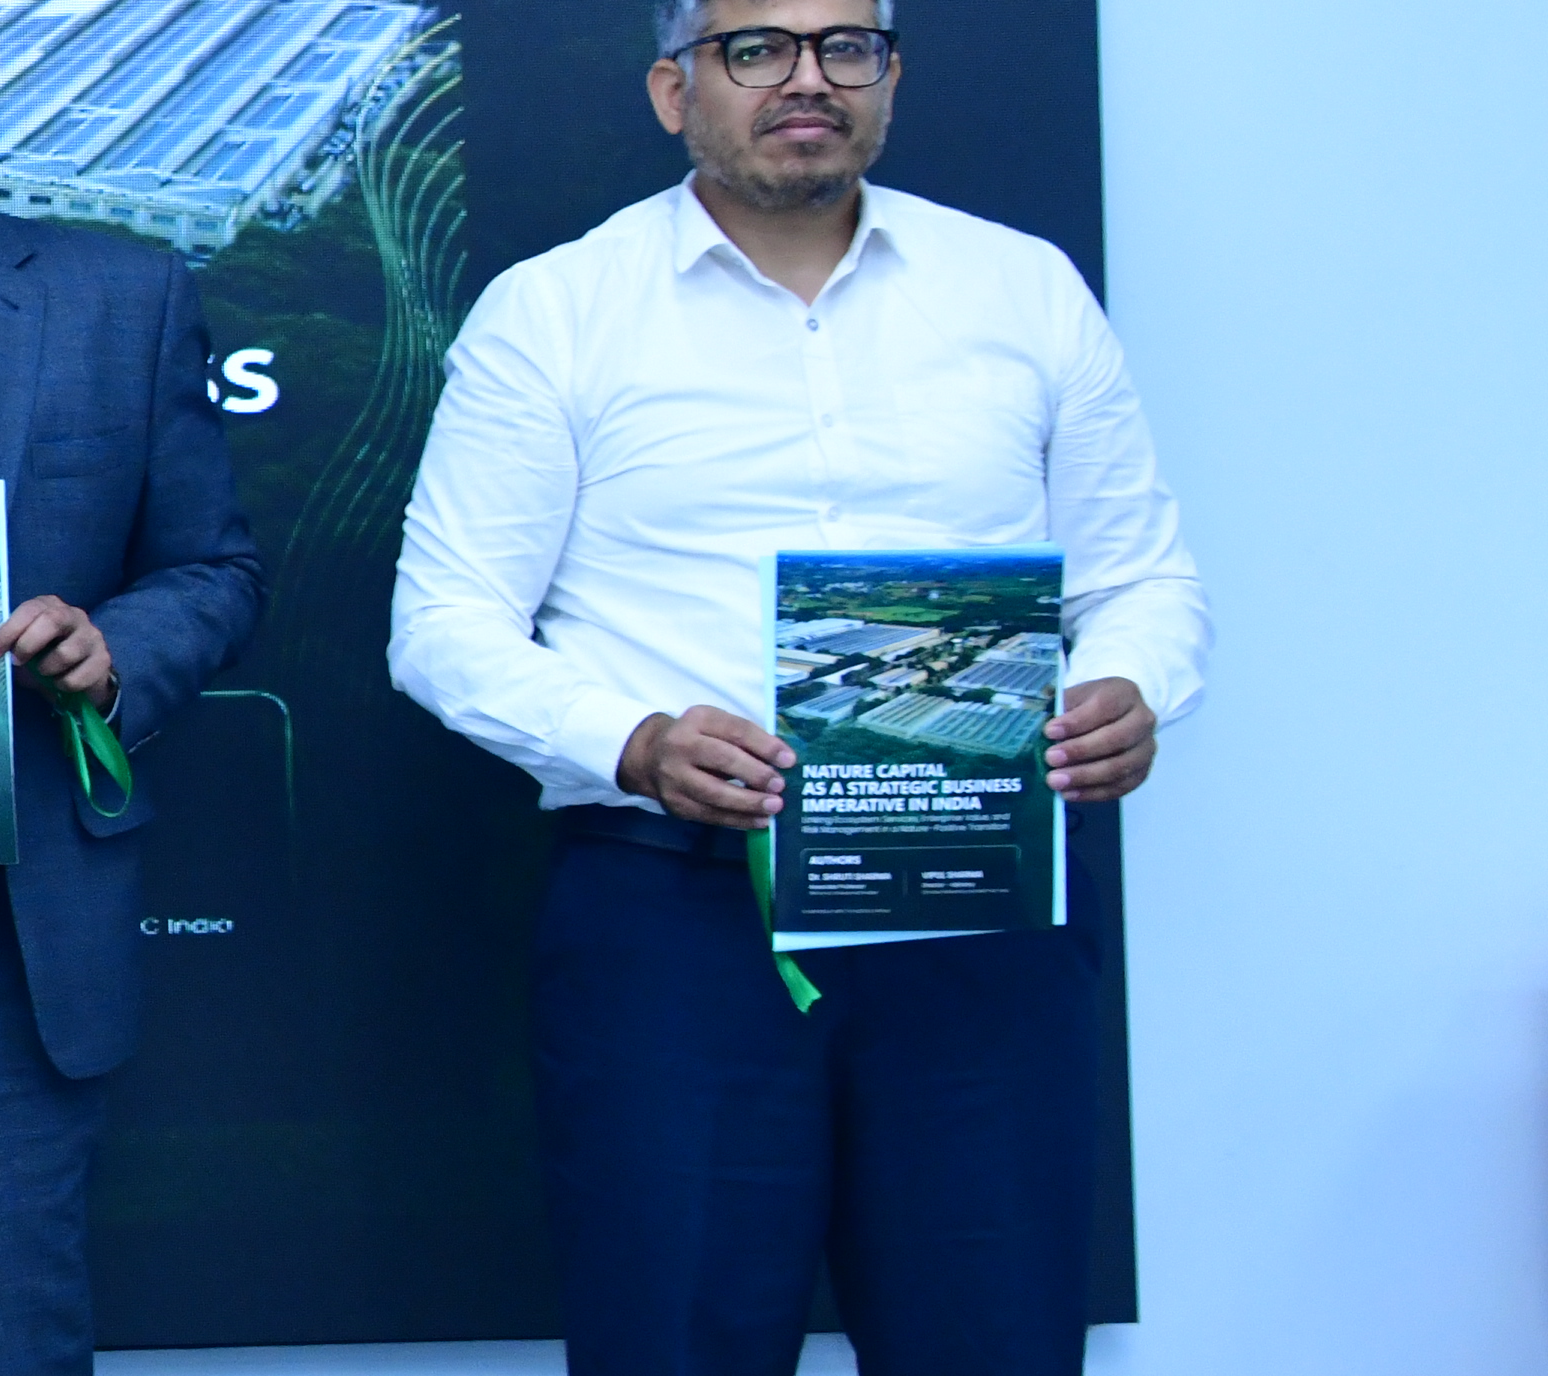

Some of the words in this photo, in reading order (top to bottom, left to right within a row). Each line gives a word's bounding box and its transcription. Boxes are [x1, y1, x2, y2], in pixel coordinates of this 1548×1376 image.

[803, 764, 871, 778] NATURE
[876, 763, 946, 776] CAPITAL
[802, 782, 825, 795] AS
[829, 781, 842, 794] A
[846, 780, 937, 794] STRATEGIC
[940, 778, 1022, 793] BUSINESS
[802, 797, 904, 812] IMPERATIVE
[908, 797, 927, 810] IN
[932, 796, 981, 809] INDIA
[808, 855, 860, 864] AUTHORS
[167, 917, 235, 935] India
